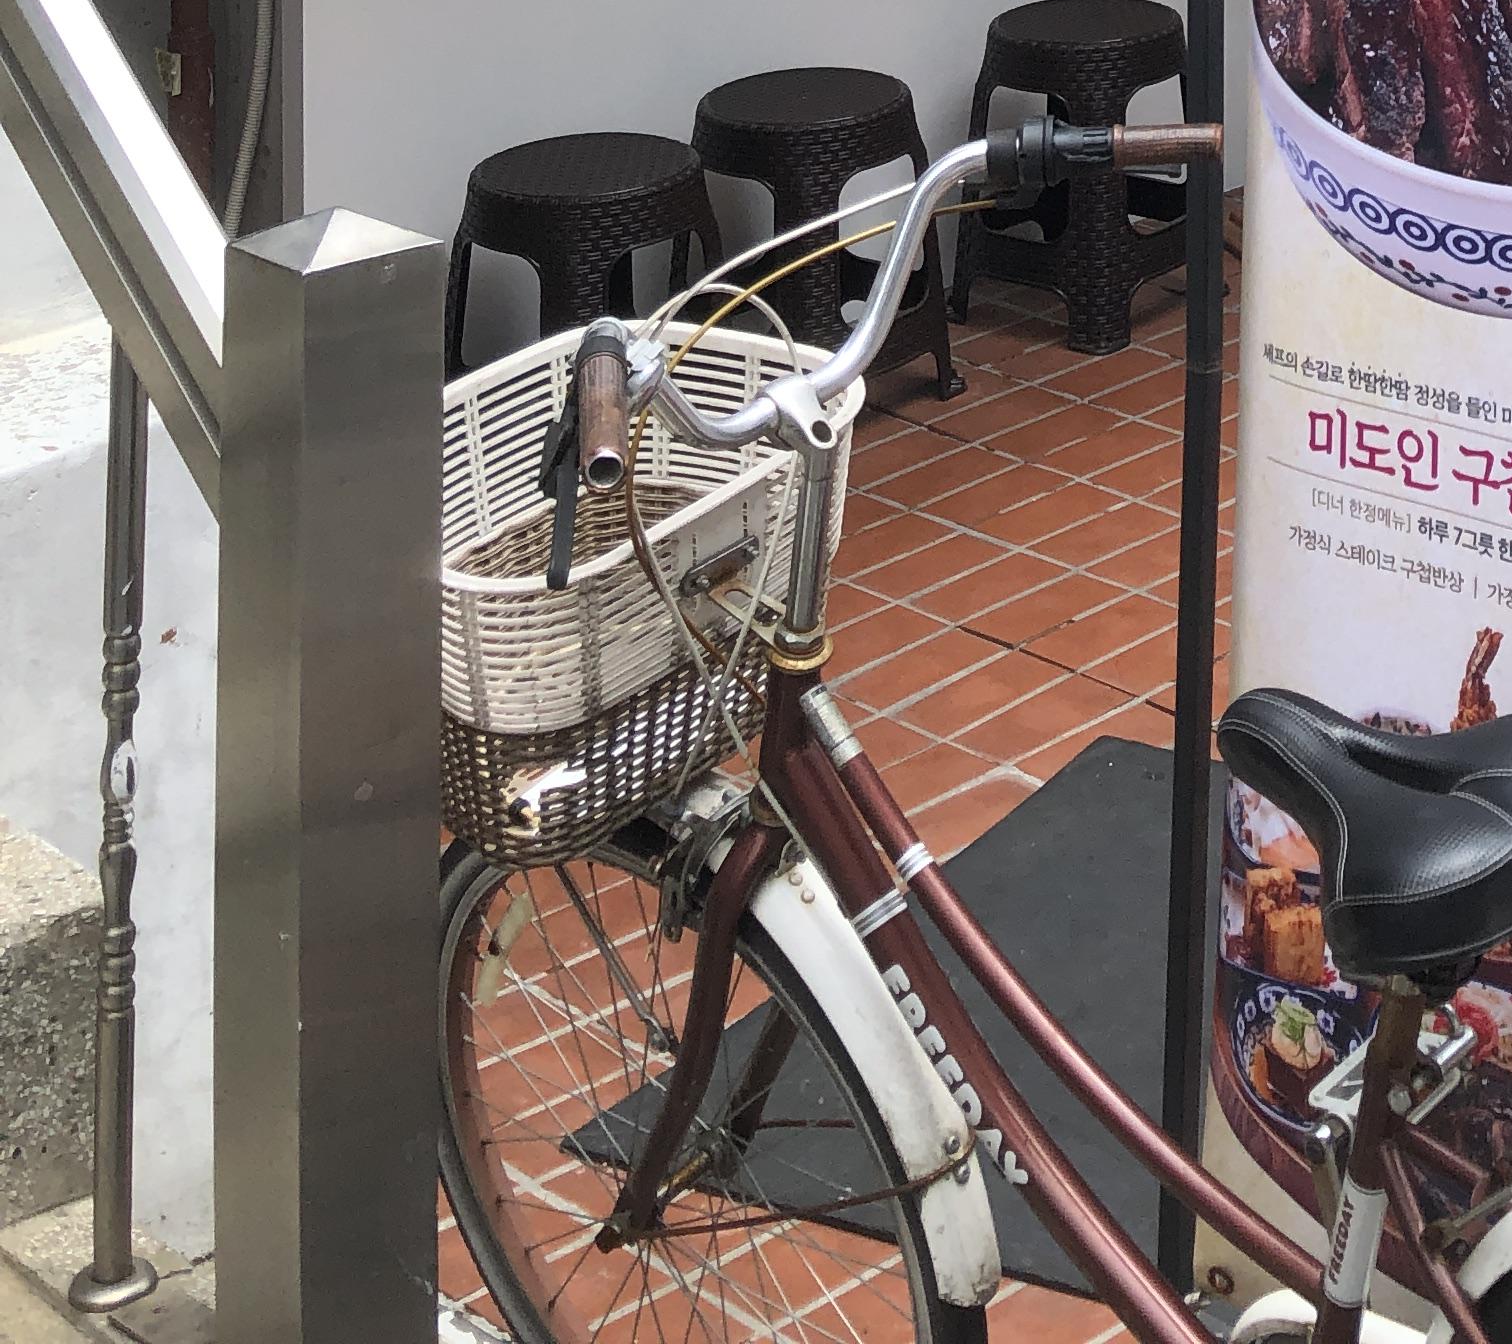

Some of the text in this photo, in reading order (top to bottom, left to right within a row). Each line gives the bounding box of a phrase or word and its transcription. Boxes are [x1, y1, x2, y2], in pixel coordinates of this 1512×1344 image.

[1301, 355, 1344, 385] 손길로
[1348, 365, 1411, 402] 한땀한땀
[1414, 384, 1462, 414] 정성을
[1466, 396, 1497, 424] 들인
[1308, 409, 1440, 491] 미도인
[1288, 525, 1332, 555] 가정식
[1335, 541, 1397, 574] 스테이크
[1400, 558, 1465, 594] 구첩반상
[1417, 516, 1450, 545] 하루
[1453, 527, 1494, 558] 7그릇
[880, 964, 1029, 1185] FREEDAY
[1328, 1193, 1354, 1286] FREEDAY
